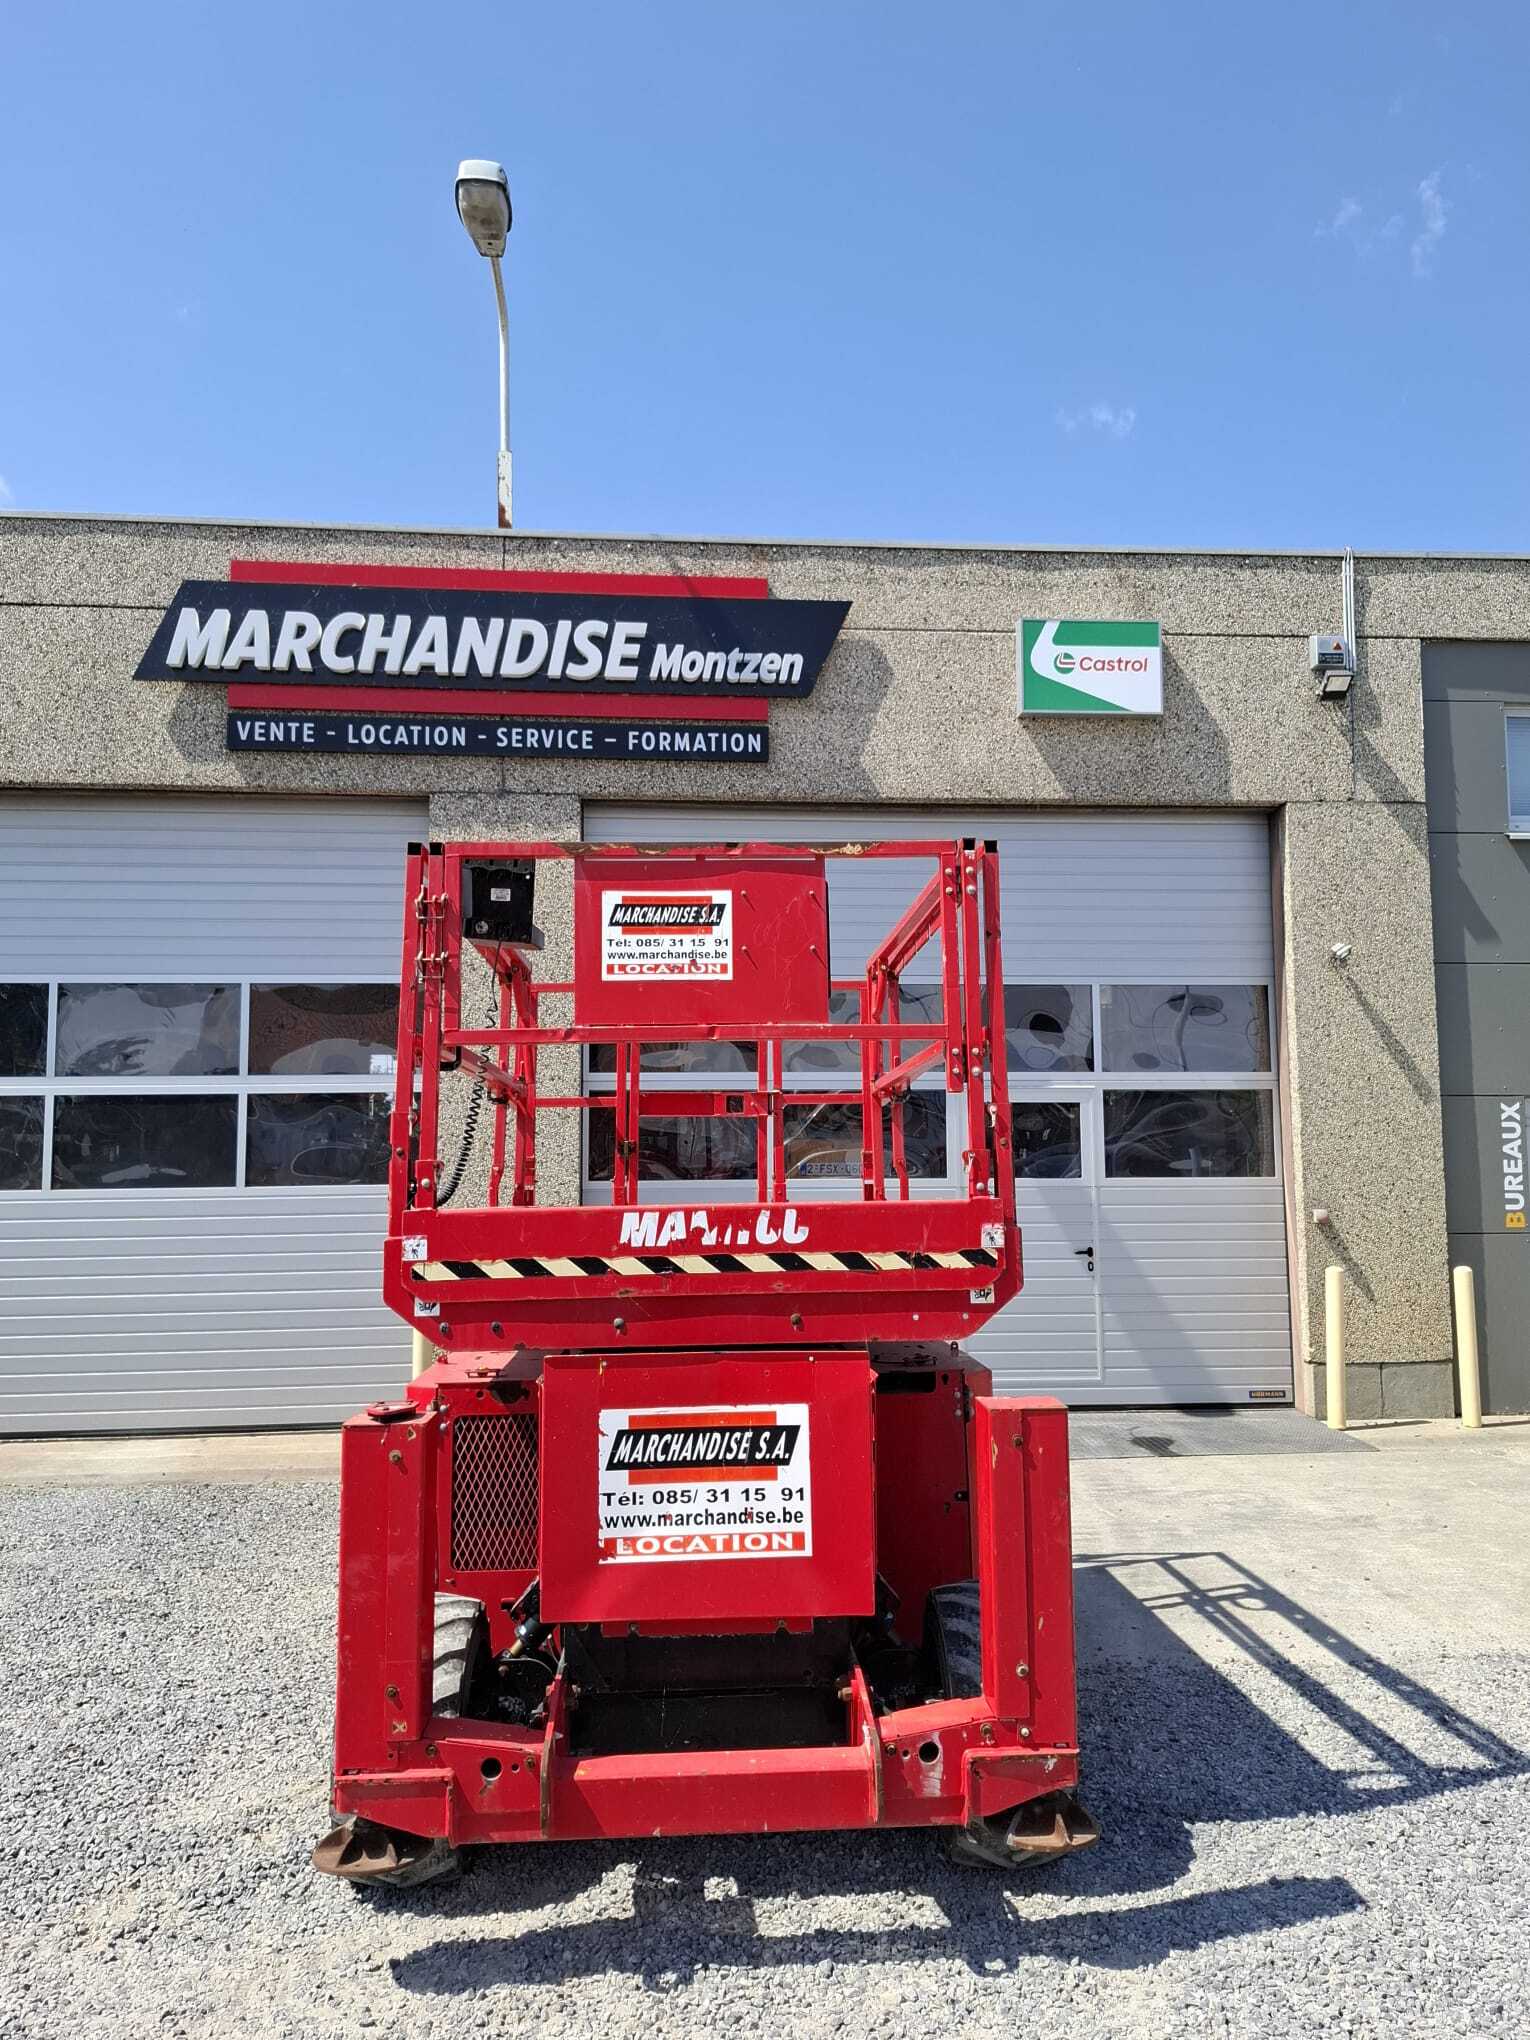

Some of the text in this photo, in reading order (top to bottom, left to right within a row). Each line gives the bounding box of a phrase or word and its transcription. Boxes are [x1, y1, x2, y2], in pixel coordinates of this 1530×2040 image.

[165, 607, 804, 685] MARCHANDISE Montzen
[1078, 656, 1148, 673] Castrol
[237, 720, 315, 743] VENTE
[347, 723, 466, 746] LOCATION
[496, 726, 594, 750] SERVICE
[628, 731, 761, 753] FORMATION
[612, 906, 721, 924] MARCHANDISE S.A.
[636, 938, 664, 948] 085/
[669, 938, 683, 948] 31
[690, 938, 706, 948] 15
[714, 938, 729, 948] 91
[607, 949, 727, 960] www.marchandise.be
[1500, 1102, 1526, 1229] BUREAUX
[613, 1430, 790, 1464] MARCHANDISE S.A.
[603, 1488, 804, 1506] Tél: 085/ 31 15 91
[605, 1507, 804, 1529] www.marchandise.be
[616, 1533, 794, 1555] LOCATION
